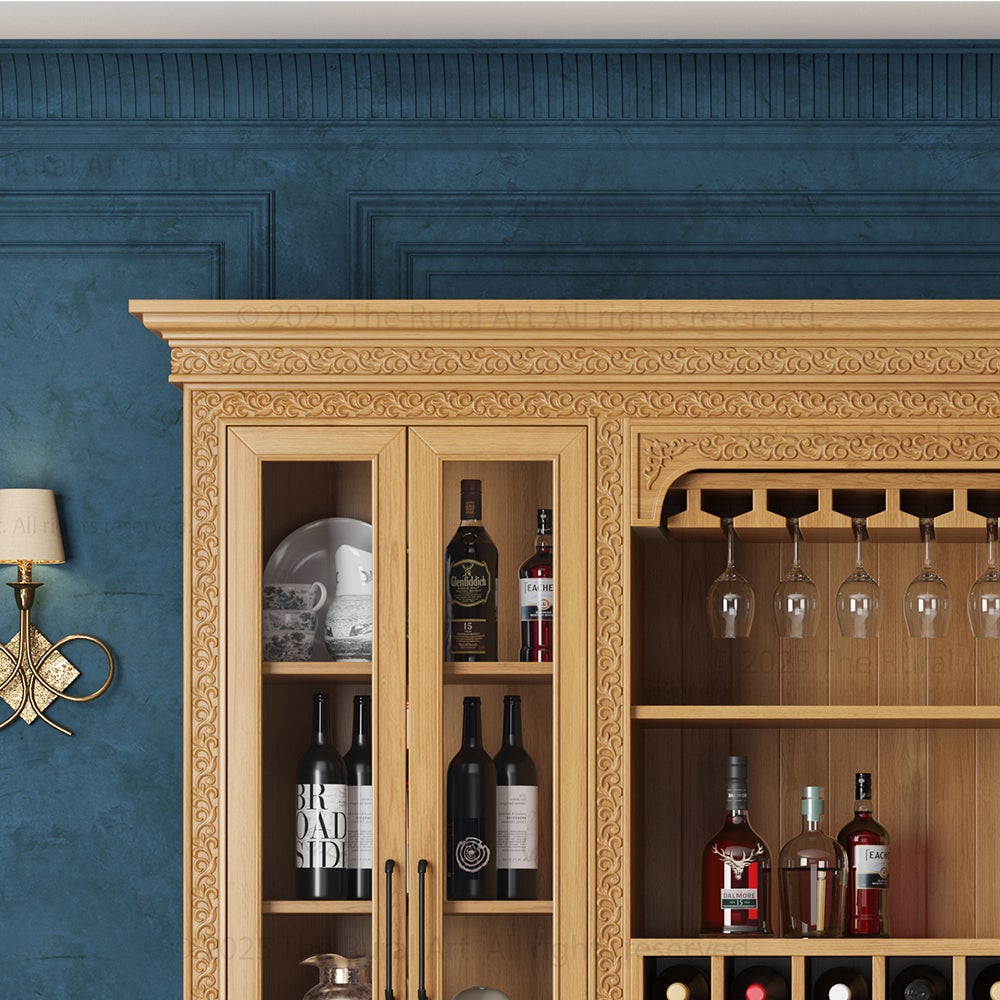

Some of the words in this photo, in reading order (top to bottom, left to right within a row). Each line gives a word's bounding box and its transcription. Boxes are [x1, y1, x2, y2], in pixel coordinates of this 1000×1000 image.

[451, 576, 487, 587] Glenfiddich
[463, 622, 473, 630] 15
[296, 811, 346, 840] OAD
